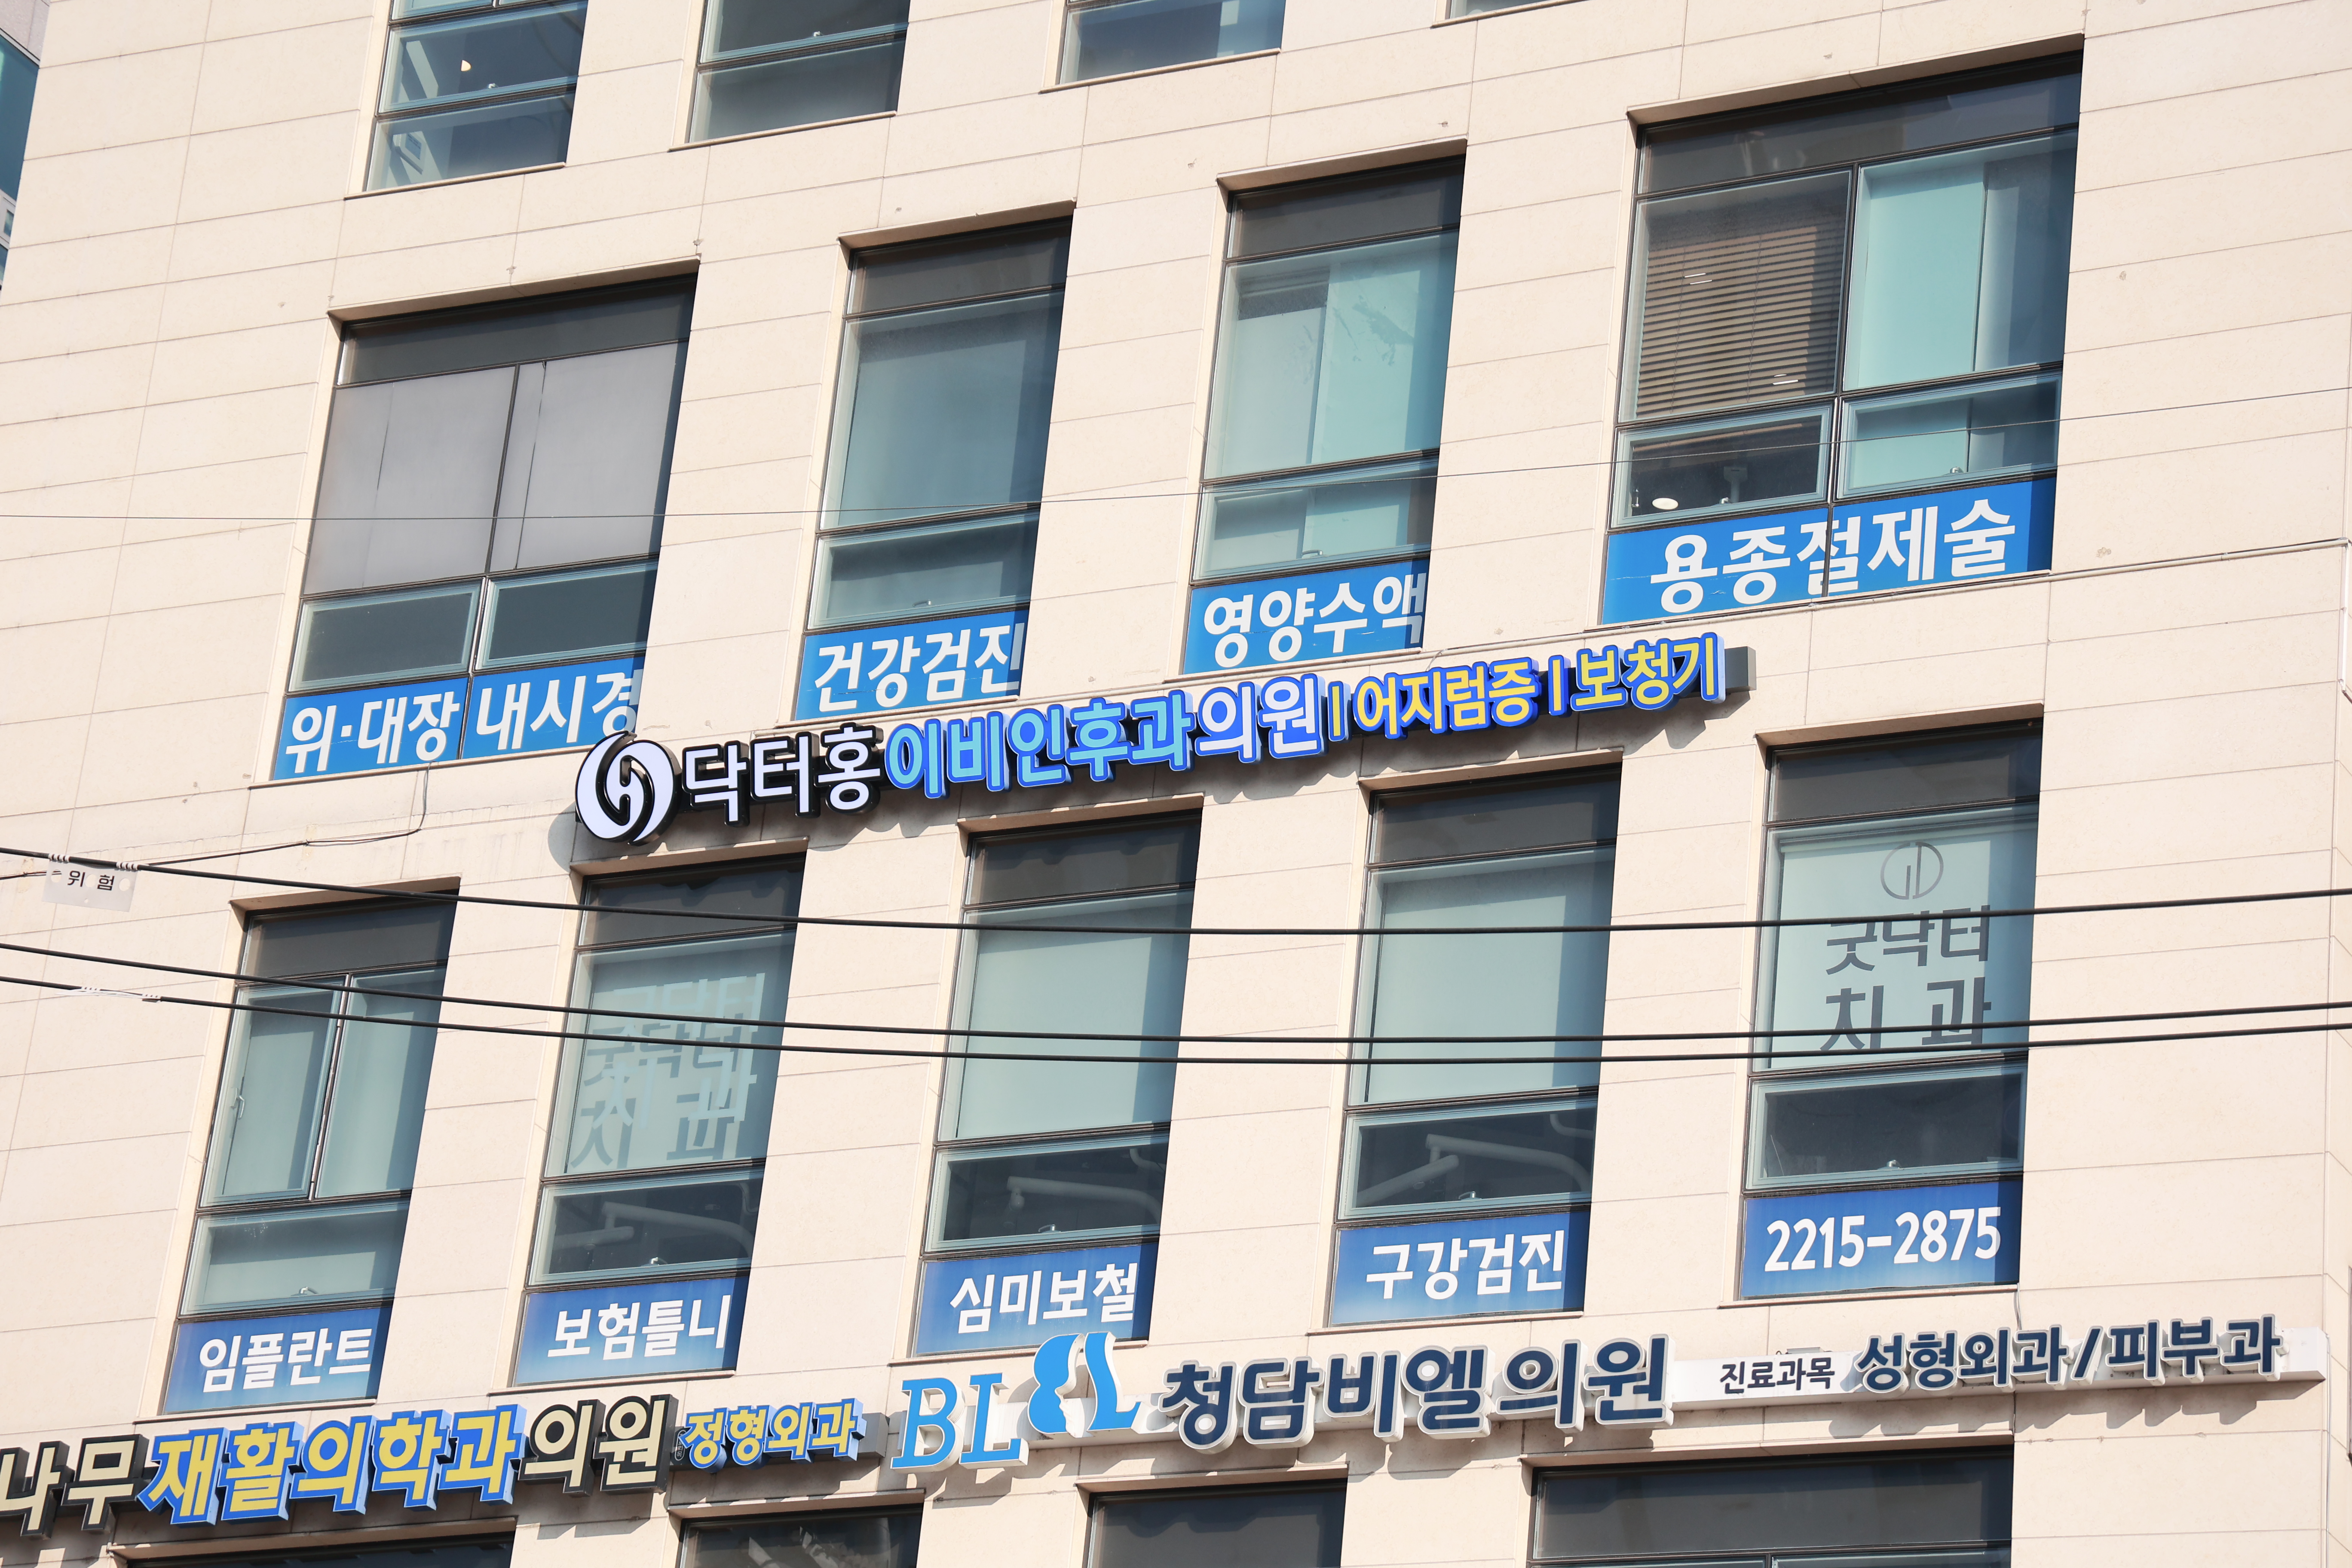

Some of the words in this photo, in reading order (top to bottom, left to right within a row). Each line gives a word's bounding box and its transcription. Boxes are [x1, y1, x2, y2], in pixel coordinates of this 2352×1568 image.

[1650, 499, 2015, 613] 용종절제술
[1204, 573, 1427, 668] 영양수액
[814, 622, 1026, 712] 건강검진
[476, 668, 643, 750] 내시경
[1825, 904, 1991, 975] 굿닥터
[1366, 1229, 1565, 1300] 구강검진
[1764, 1206, 2002, 1272] 2215-2875
[547, 1294, 731, 1361] 보험틀니
[949, 1262, 1138, 1334] 심미보철
[199, 1328, 373, 1393] 임플란트
[1719, 1357, 1835, 1394] 진료과목
[685, 1403, 856, 1464] 정형외과
